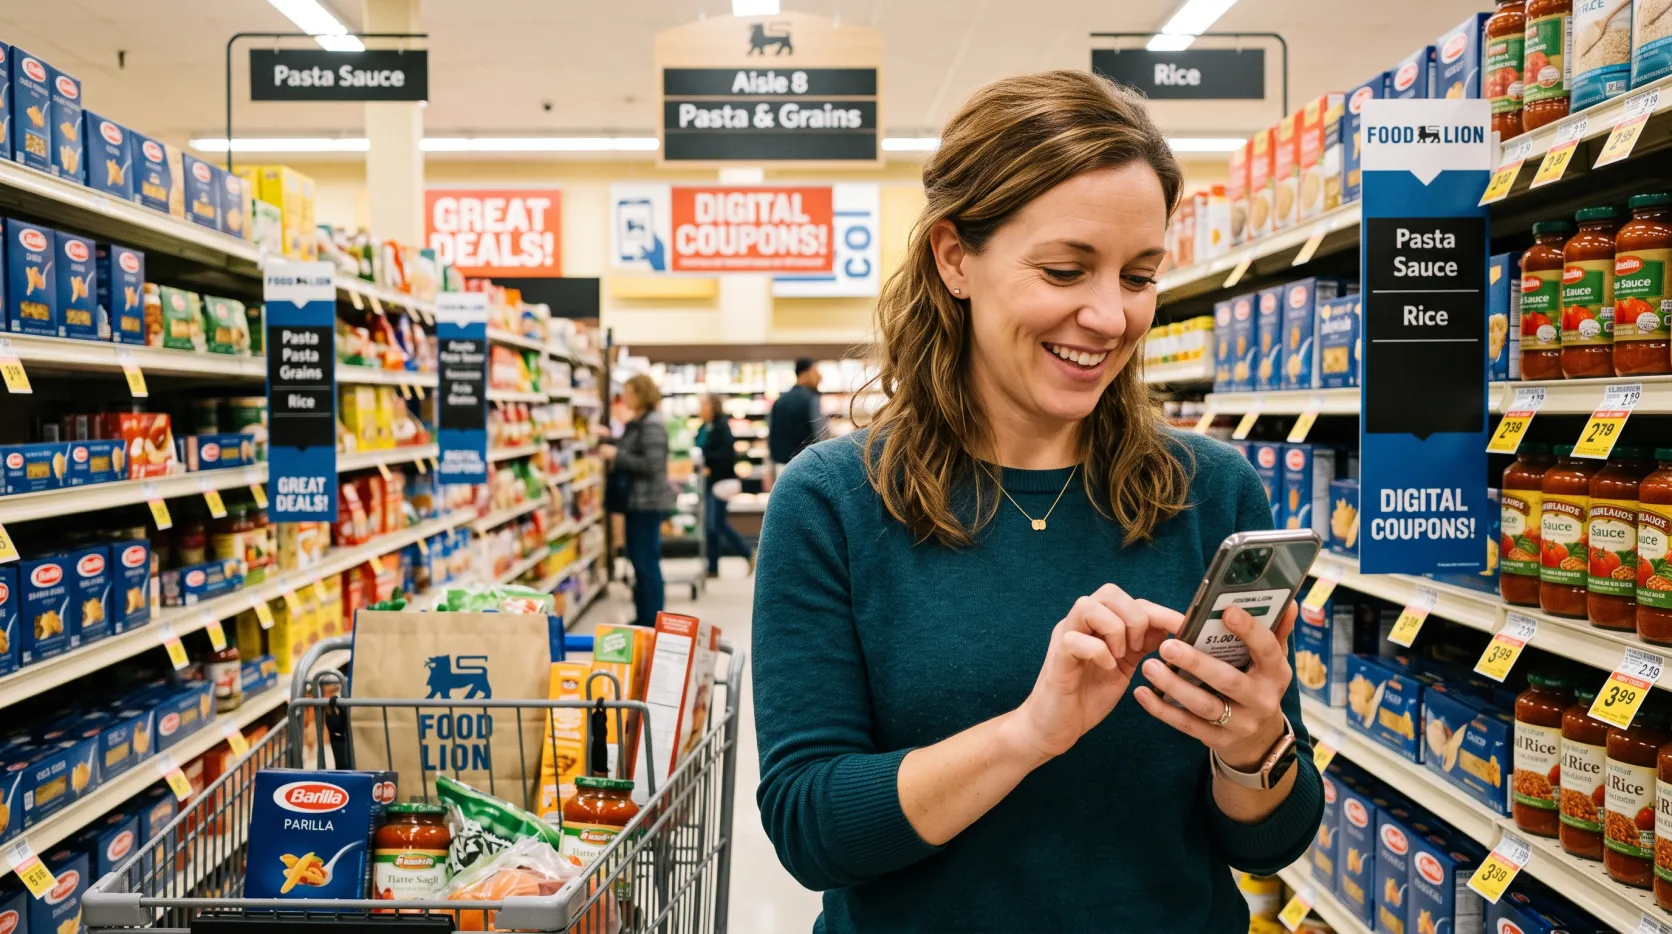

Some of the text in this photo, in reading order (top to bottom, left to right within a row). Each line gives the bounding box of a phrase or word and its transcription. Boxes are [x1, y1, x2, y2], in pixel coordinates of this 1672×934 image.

[273, 64, 405, 88] Pasta Sauce
[732, 70, 808, 94] Aisle 8
[1154, 63, 1202, 86] Rice
[679, 103, 862, 129] Pasta & Grains
[1367, 126, 1484, 144] FOOD LION
[433, 197, 551, 232] GREAT
[694, 192, 810, 224] DIGITAL
[675, 223, 829, 257] COUPONS!
[1395, 227, 1456, 249] Pasta
[430, 232, 554, 269] DEALS!
[1393, 255, 1459, 277] Sauce
[1403, 304, 1449, 326] Rice
[281, 330, 320, 346] Pasta
[281, 347, 320, 363] Pasta
[279, 365, 323, 381] Grains
[287, 393, 316, 409] Rice
[277, 476, 327, 495] GREAT
[275, 494, 329, 513] DEALS!
[1380, 487, 1469, 513] DIGITAL
[1371, 517, 1476, 541] COUPONS!
[1543, 518, 1572, 532] Sauce
[1591, 524, 1625, 539] Sauce
[1205, 634, 1235, 644] $1.00
[420, 713, 494, 741] FOOD
[421, 743, 491, 771] LION
[1524, 737, 1557, 755] Rice
[1569, 754, 1601, 774] Rice
[1611, 774, 1645, 796] Rice
[290, 788, 344, 805] Barilla
[283, 818, 334, 832] PARILLA
